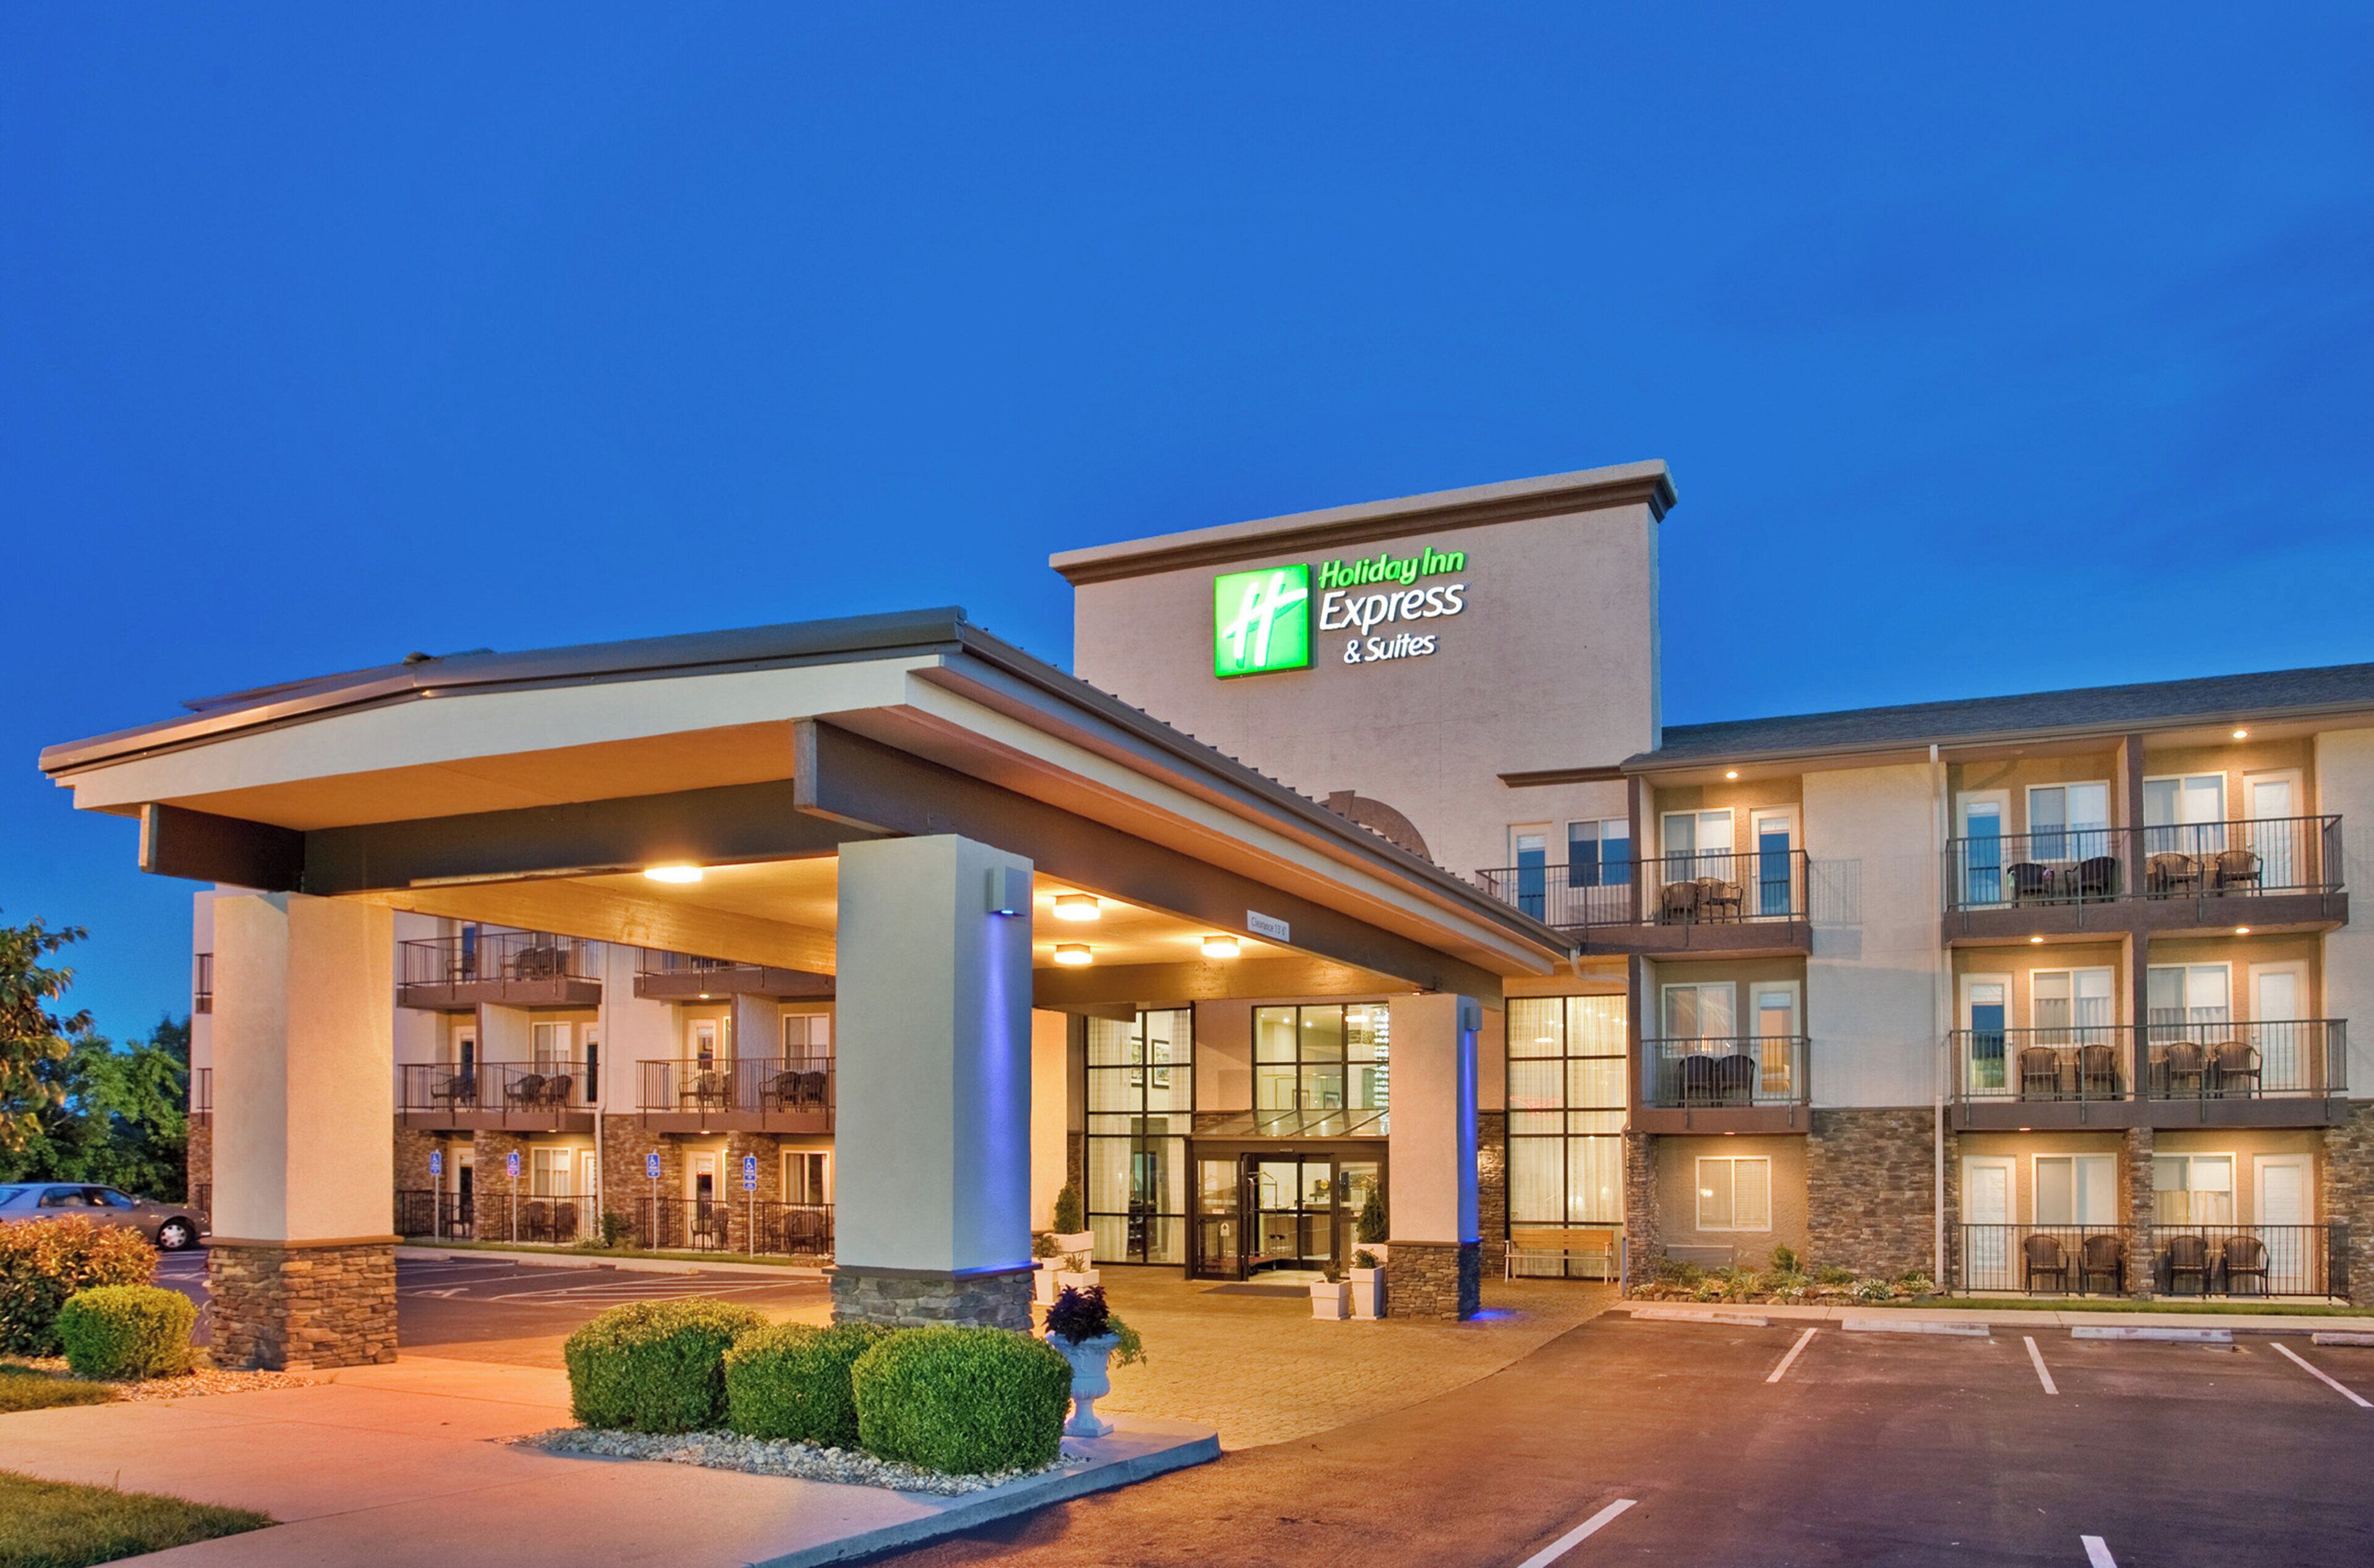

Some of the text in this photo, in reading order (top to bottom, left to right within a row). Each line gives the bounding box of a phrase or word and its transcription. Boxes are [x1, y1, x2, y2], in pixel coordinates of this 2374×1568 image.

[1319, 546, 1465, 590] Holiday Inn
[1319, 584, 1465, 636] Express
[1343, 633, 1436, 664] & Suites
